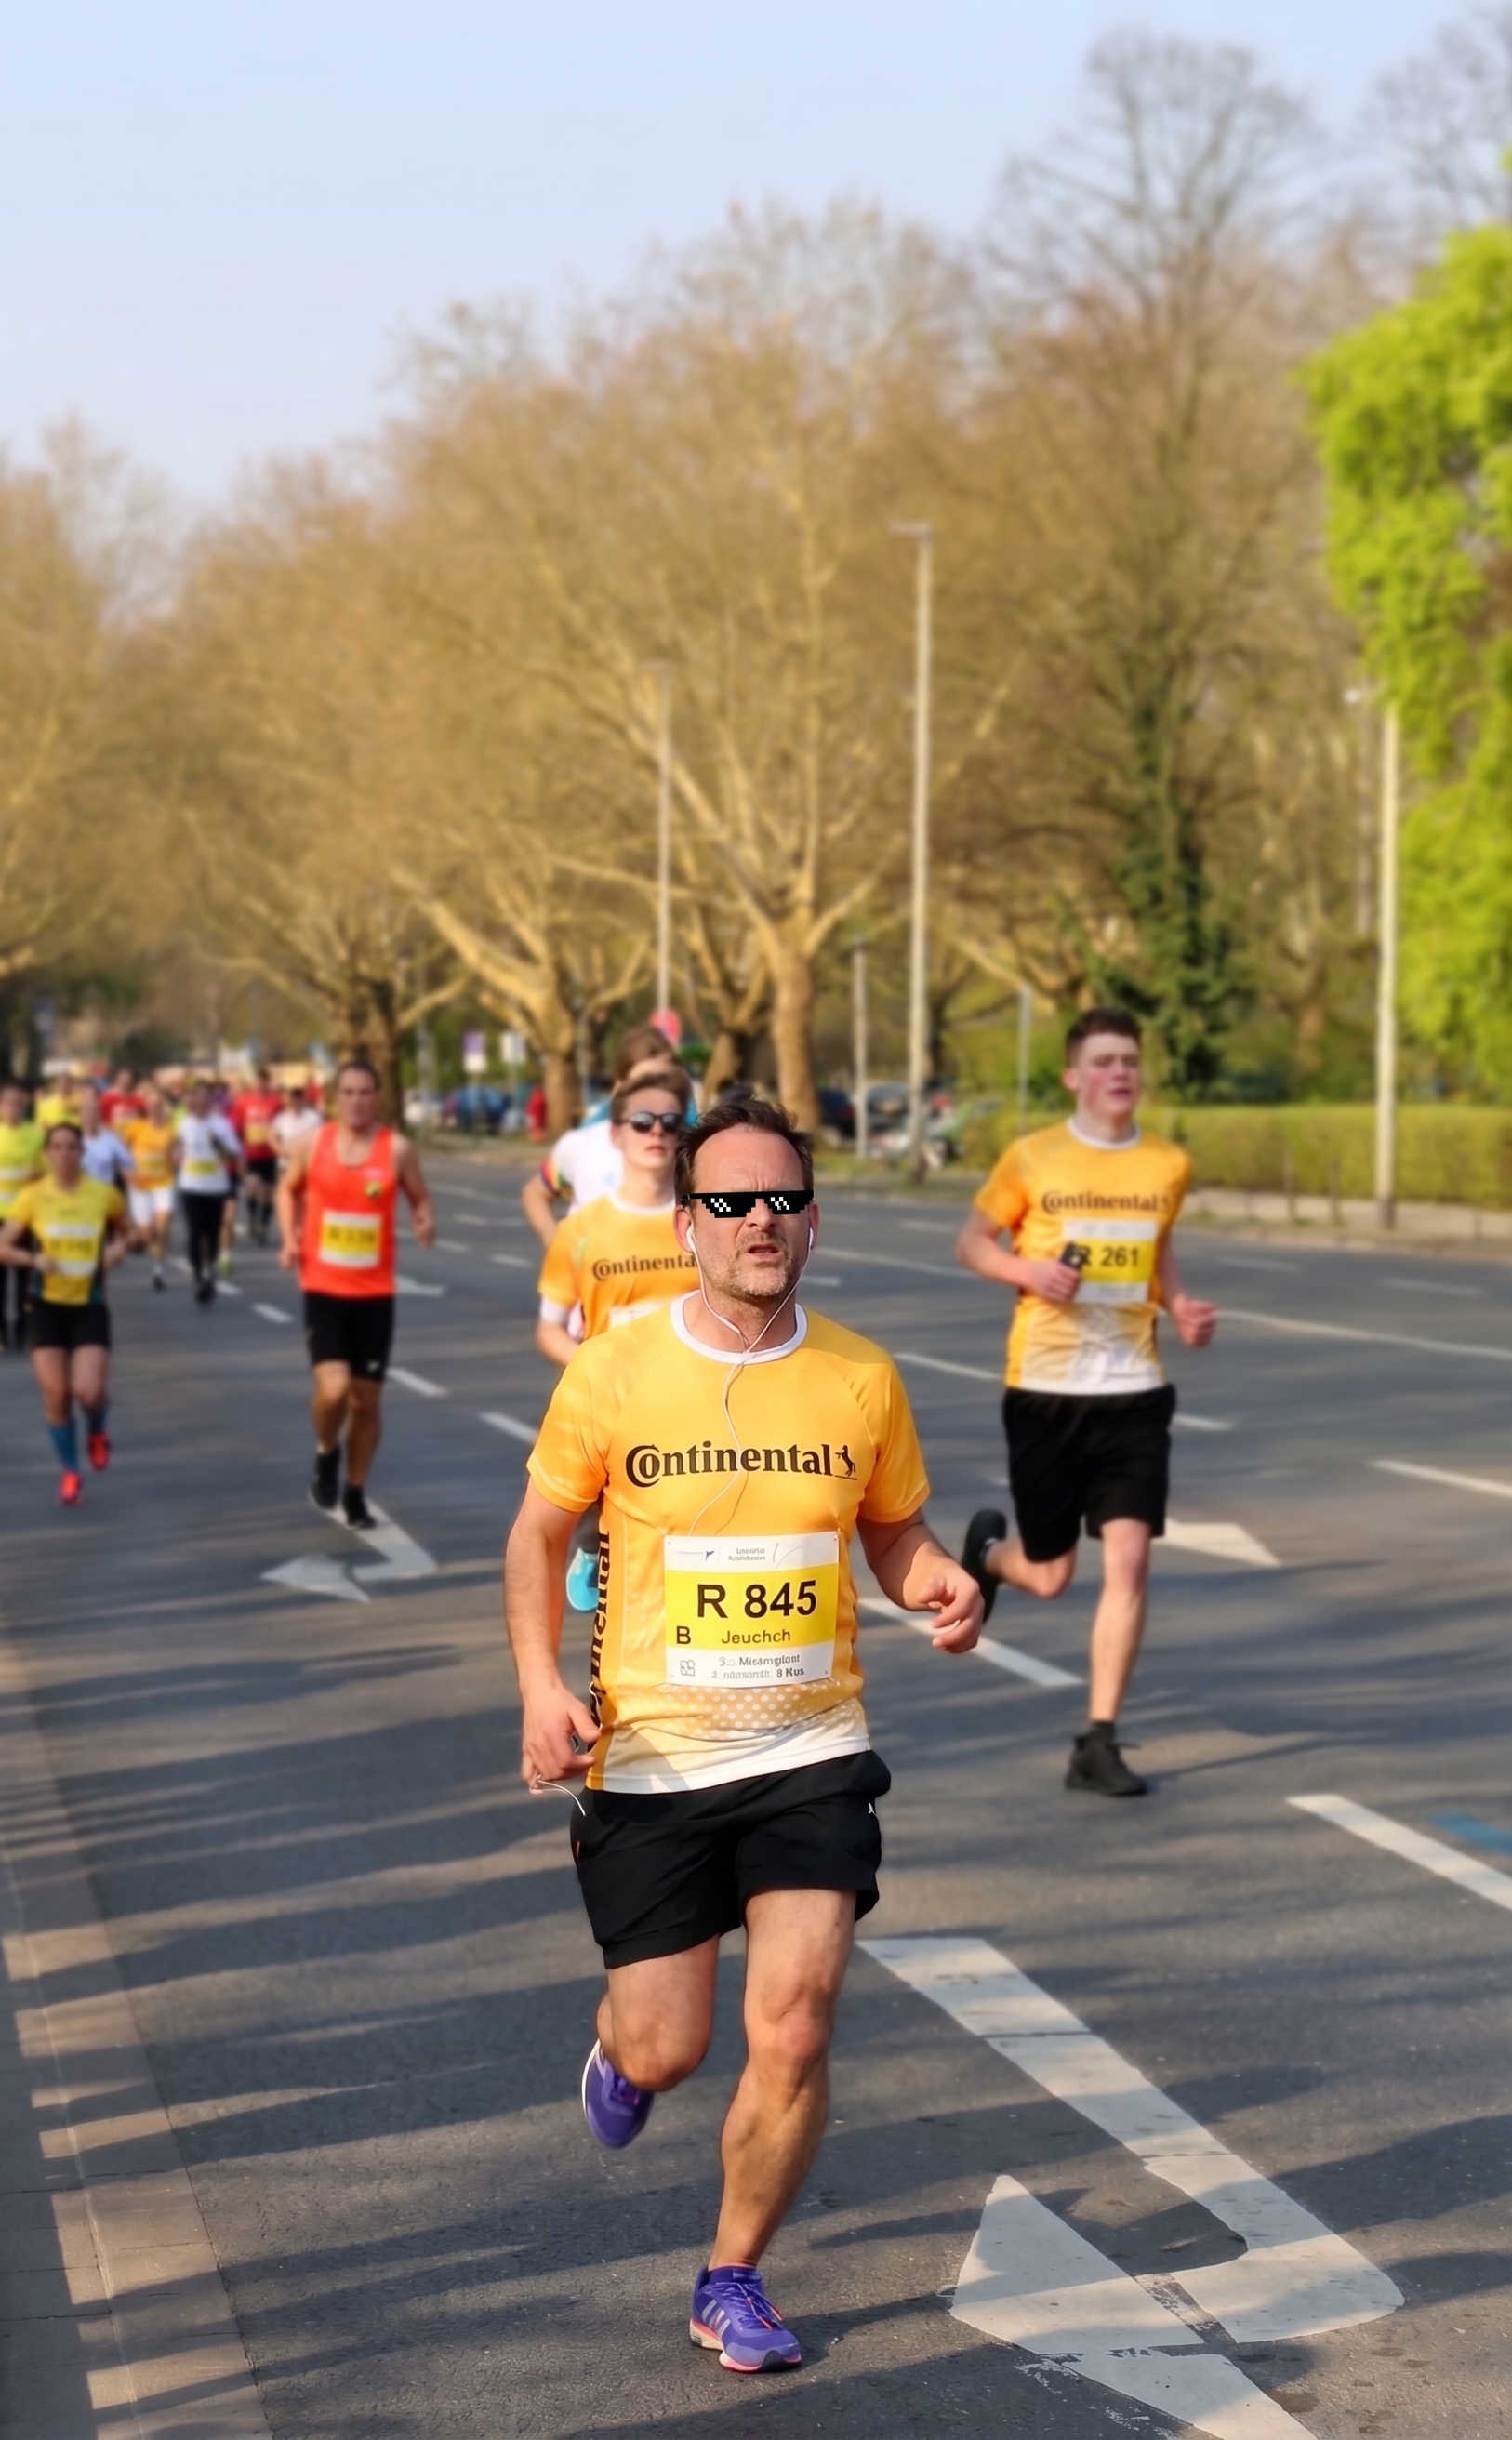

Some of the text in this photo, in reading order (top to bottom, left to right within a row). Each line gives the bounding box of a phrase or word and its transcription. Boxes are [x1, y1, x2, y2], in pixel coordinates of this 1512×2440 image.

[1042, 1189, 1159, 1214] Continental
[591, 1254, 699, 1282] Continenta
[1100, 1245, 1140, 1267] 261
[625, 1440, 833, 1488] Continental
[697, 1580, 816, 1619] R 845
[676, 1625, 791, 1645] B Jeuchch
